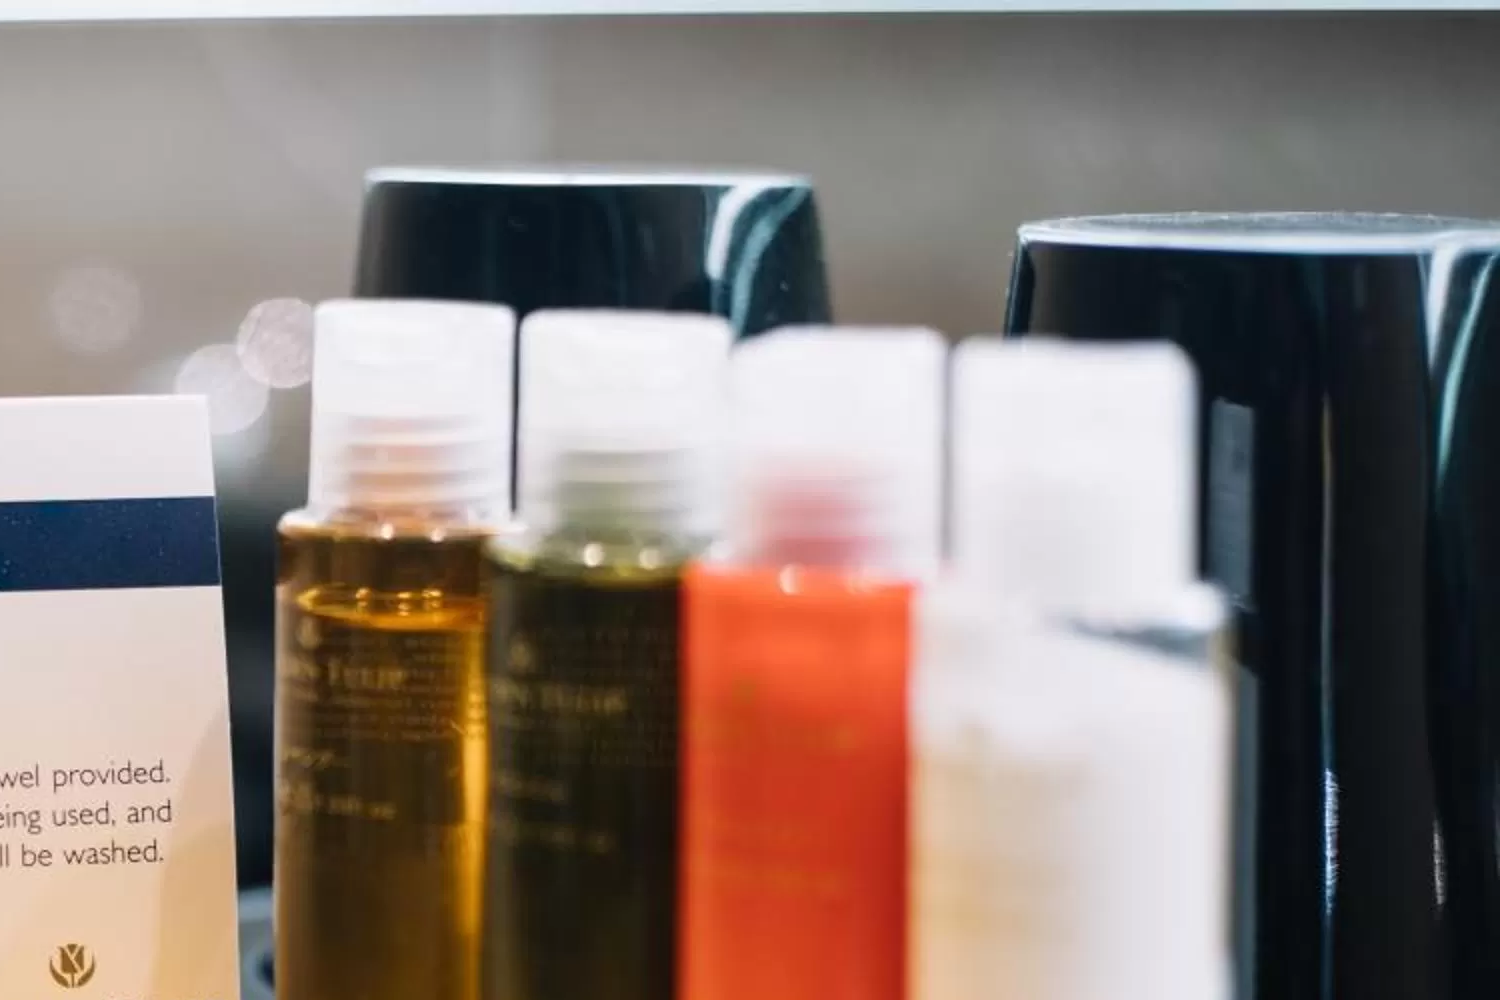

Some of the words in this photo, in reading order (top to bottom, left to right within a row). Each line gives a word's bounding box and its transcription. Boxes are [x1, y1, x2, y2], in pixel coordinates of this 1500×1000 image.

[52, 759, 171, 794] provided.
[52, 802, 116, 828] used,
[127, 800, 172, 825] and
[21, 843, 53, 868] be
[64, 838, 164, 866] washed.
